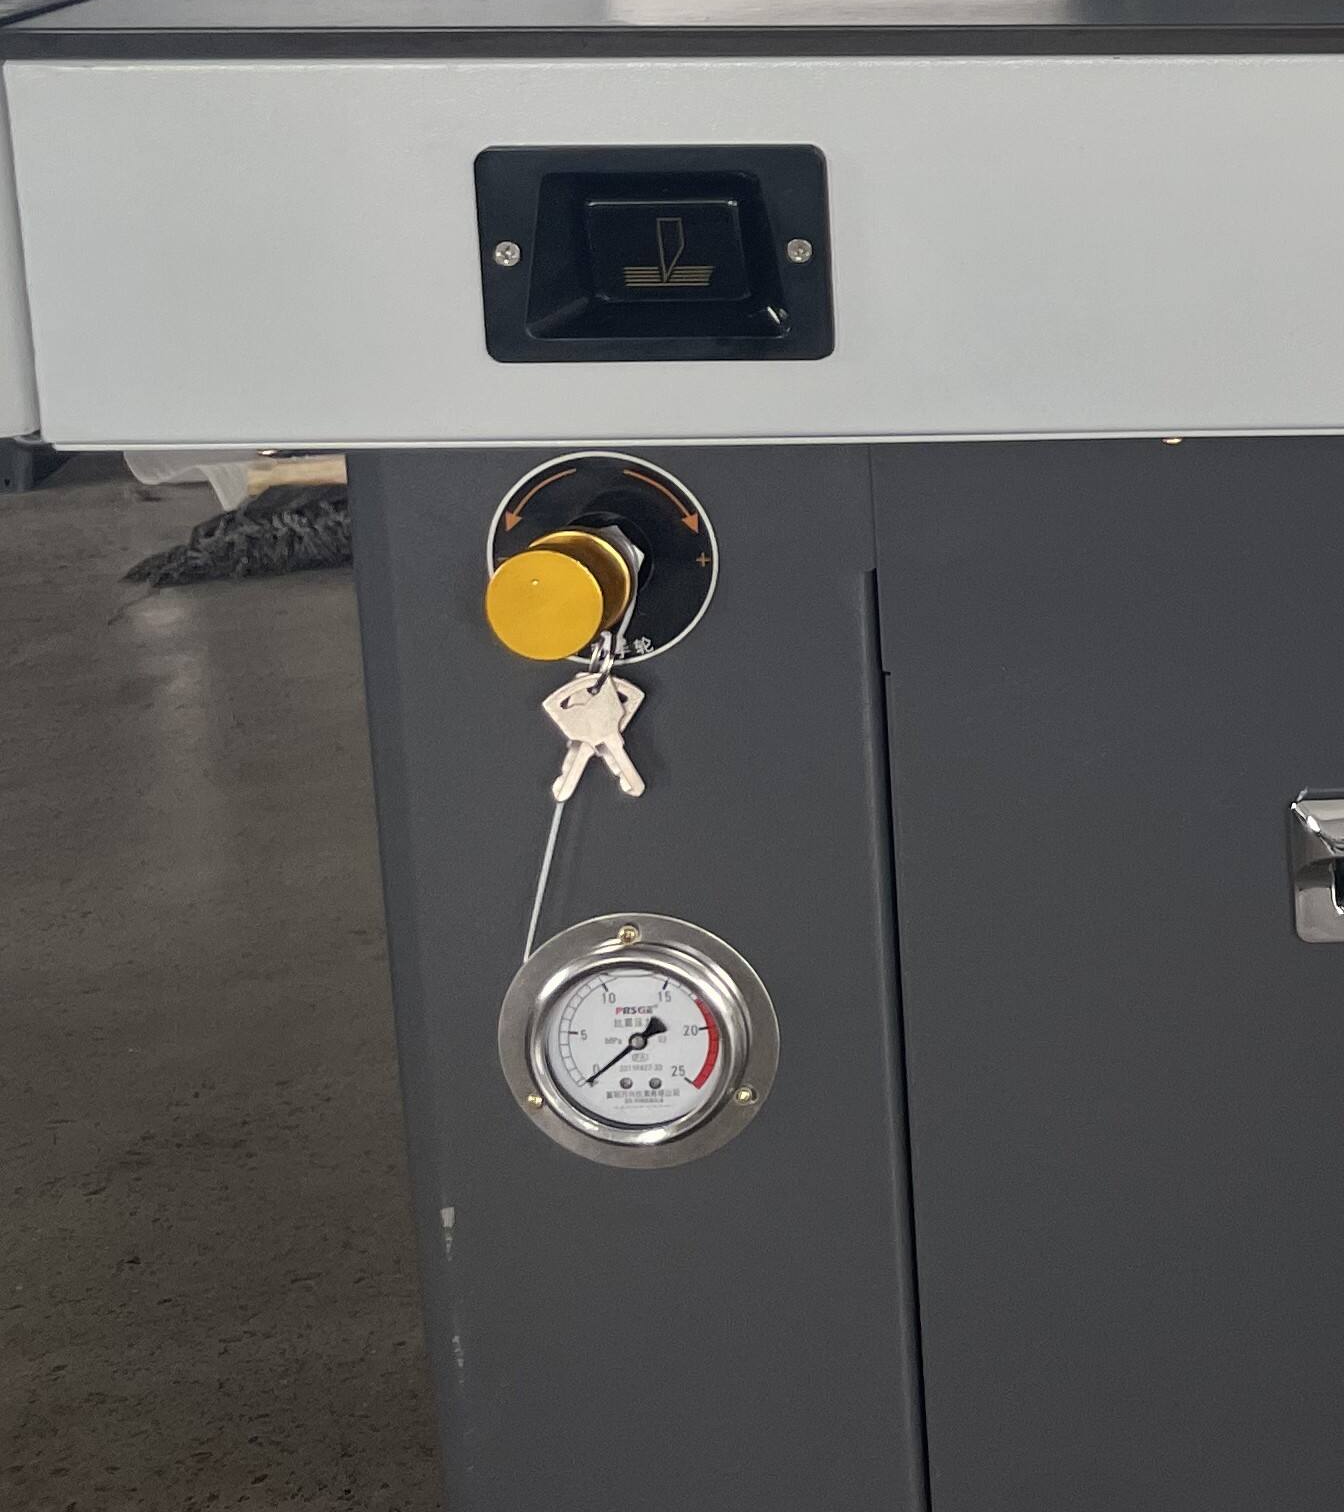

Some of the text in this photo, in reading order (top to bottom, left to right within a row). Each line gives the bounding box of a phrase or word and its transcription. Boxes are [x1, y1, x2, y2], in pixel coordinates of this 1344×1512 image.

[602, 992, 616, 1004] 10
[657, 990, 672, 1003] 15
[580, 1029, 588, 1040] 5
[683, 1025, 698, 1037] 20
[671, 1065, 686, 1077] 25
